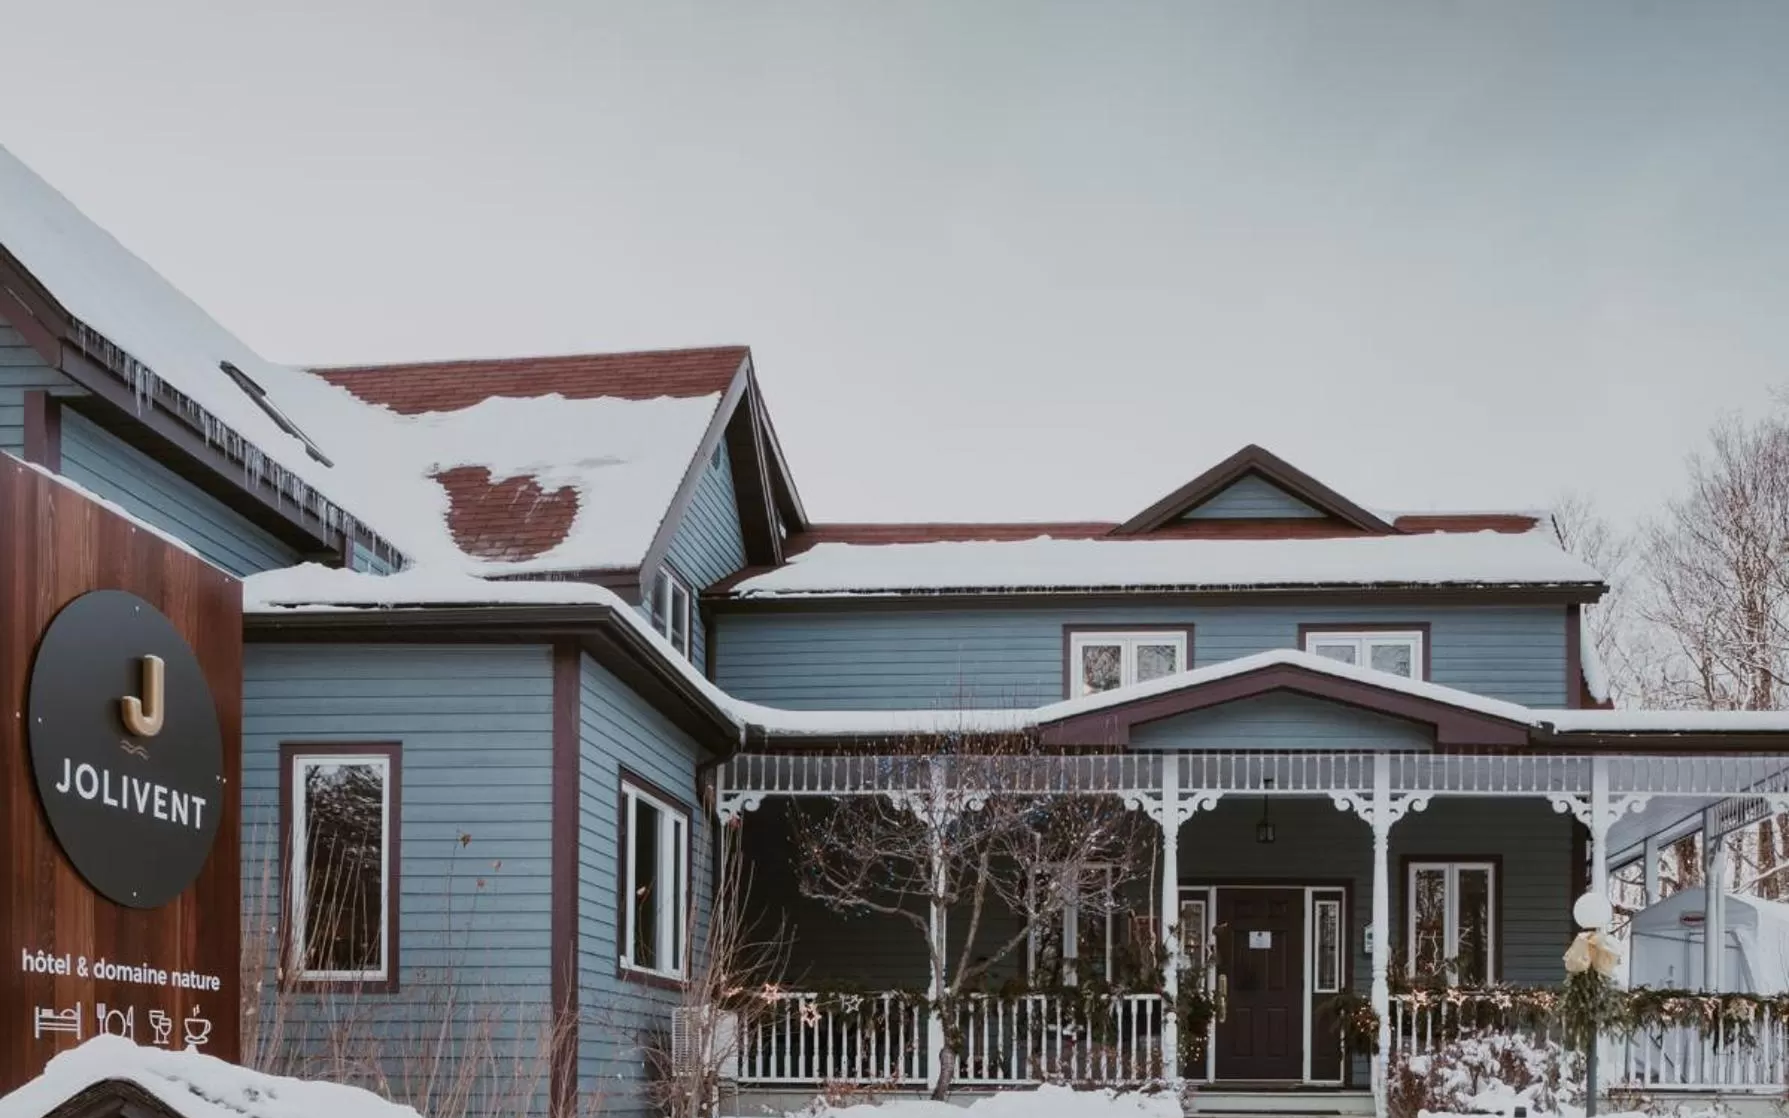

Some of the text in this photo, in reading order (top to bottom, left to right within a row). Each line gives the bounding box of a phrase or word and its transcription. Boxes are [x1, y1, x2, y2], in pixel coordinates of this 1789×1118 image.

[121, 654, 164, 736] J
[55, 758, 207, 829] JOLIVENT
[22, 948, 221, 991] hôtel & domaine nature
